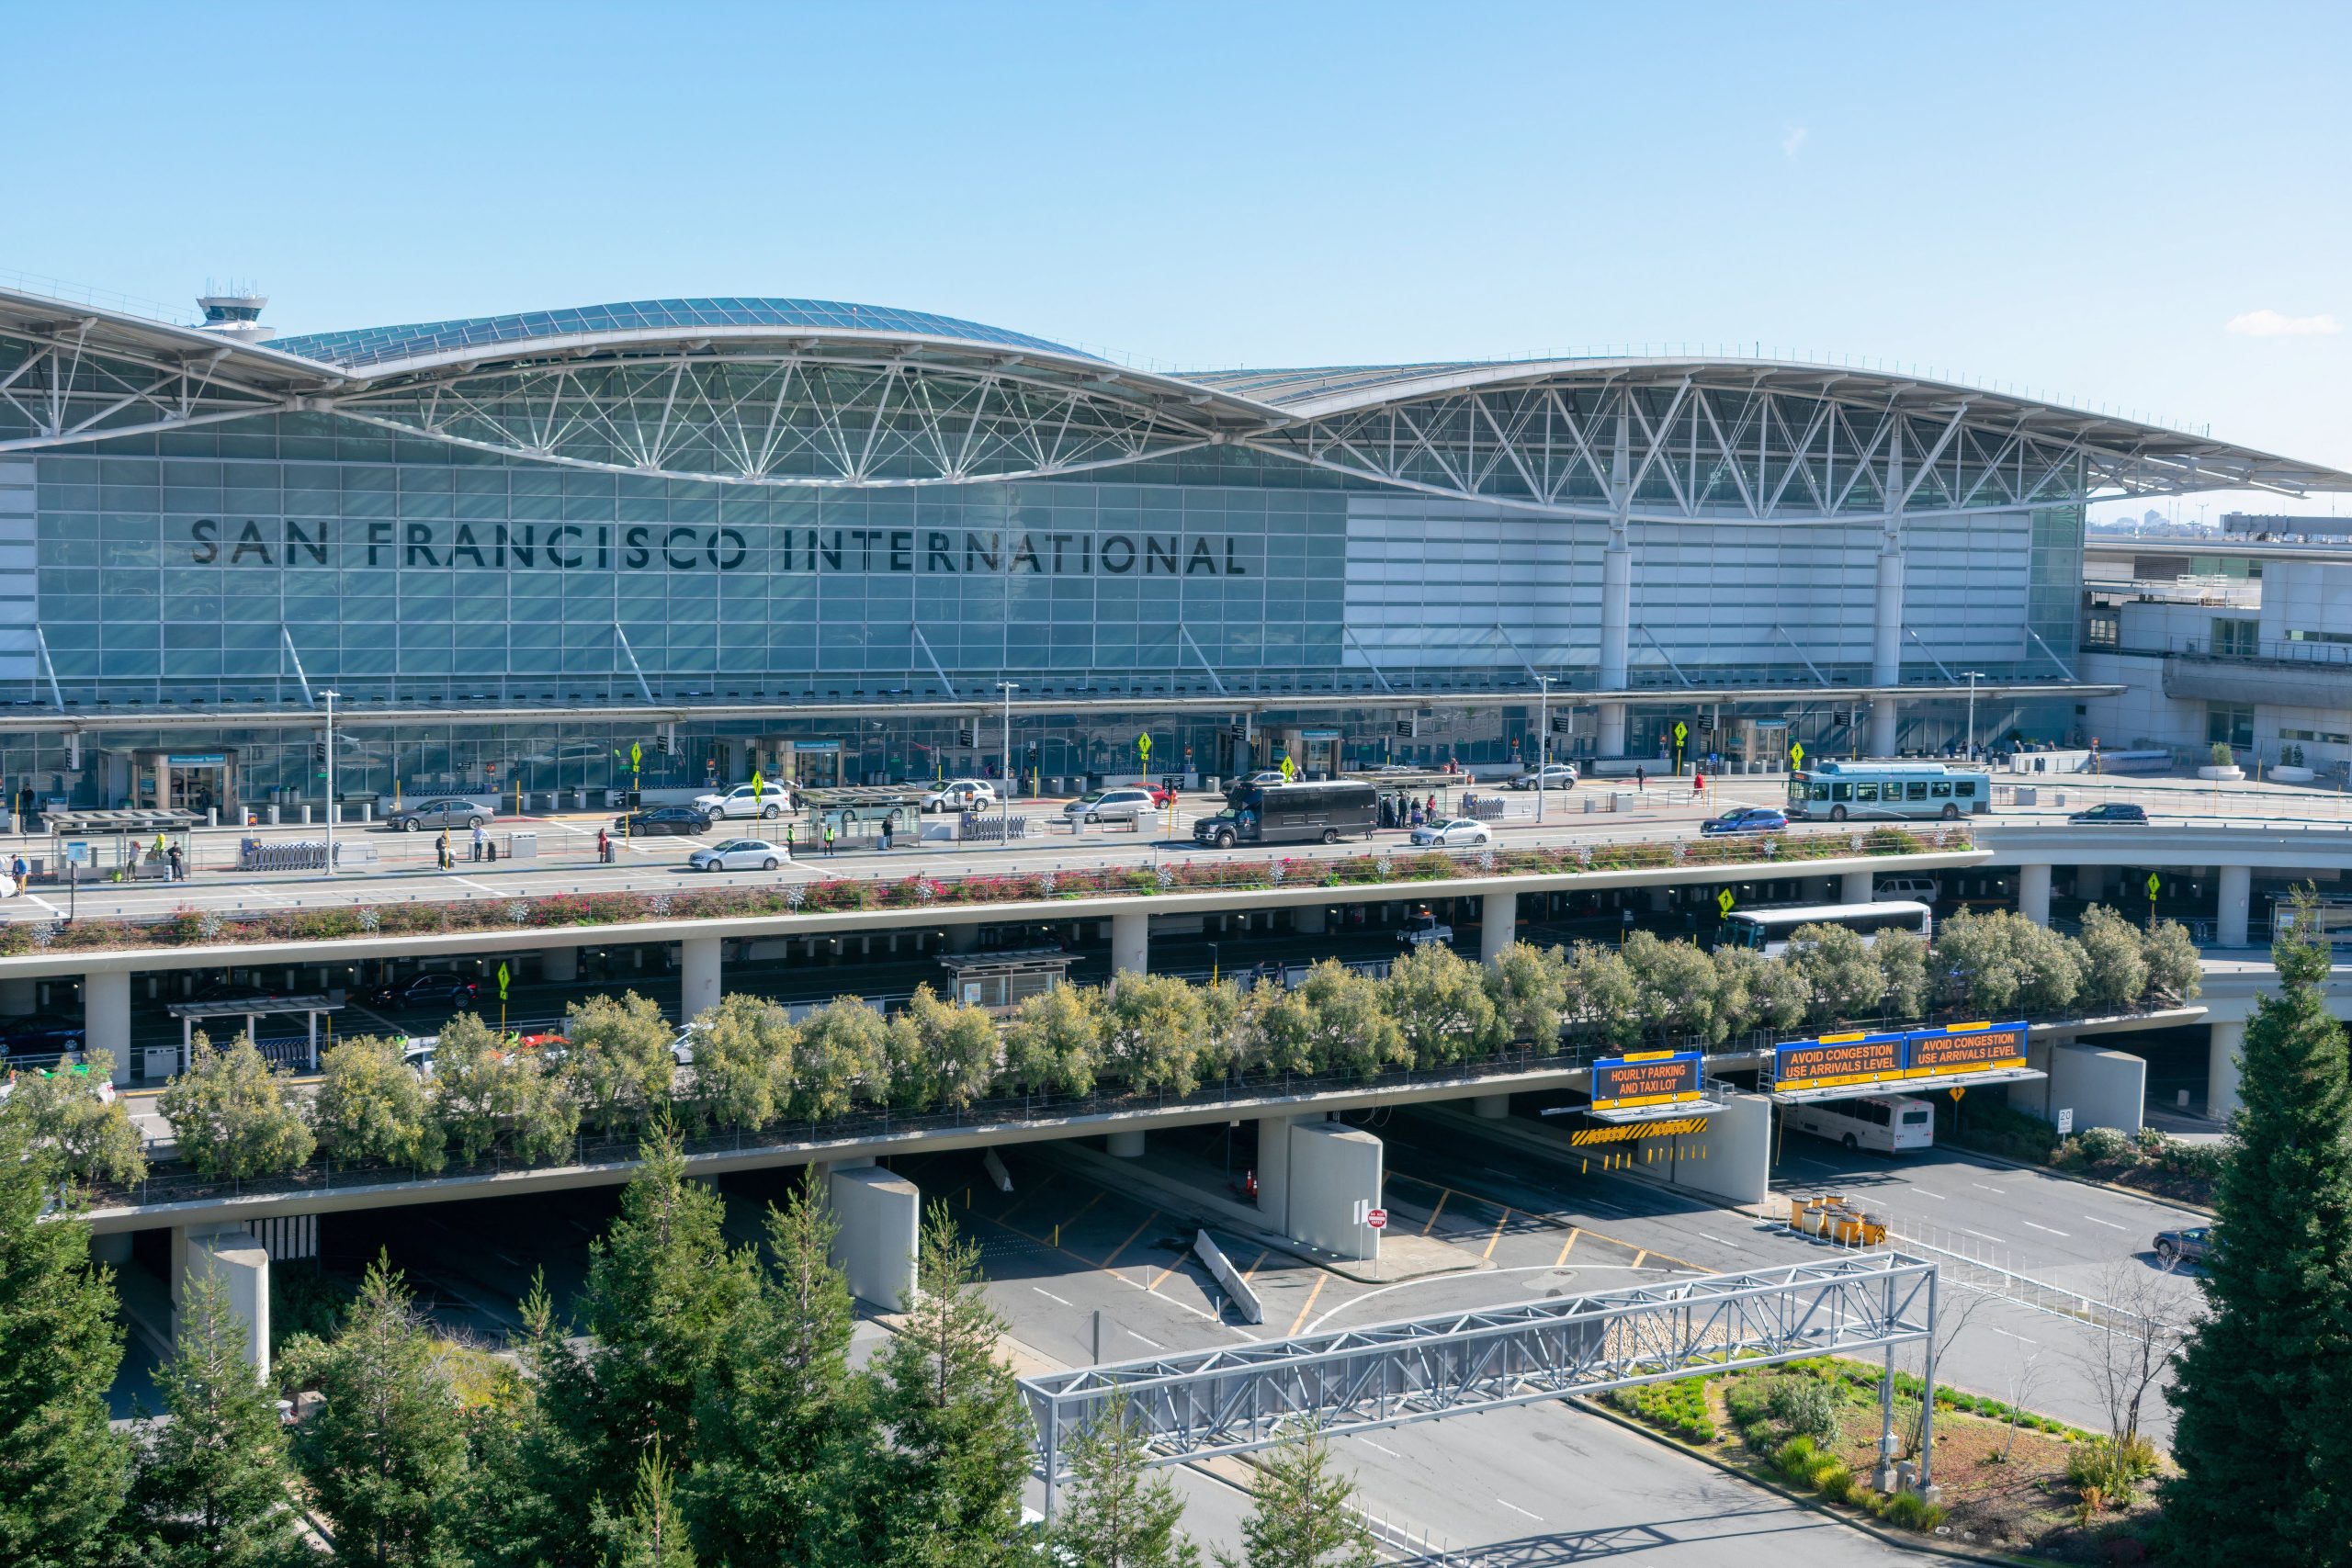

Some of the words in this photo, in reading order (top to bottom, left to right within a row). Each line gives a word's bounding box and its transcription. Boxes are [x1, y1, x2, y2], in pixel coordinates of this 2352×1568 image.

[191, 519, 328, 566] SAN
[368, 522, 748, 570] FRANCISCO
[784, 528, 1246, 575] INTERNATIONAL
[1922, 1038, 1951, 1052] AVOID
[1953, 1032, 2015, 1049] CONGESTION
[1637, 1053, 1660, 1061] Domestic
[1791, 1051, 1824, 1065] AVOID
[1826, 1044, 1894, 1061] CONGESTION
[1917, 1052, 1938, 1065] USE
[1939, 1047, 1986, 1063] ARRIVALS
[1988, 1045, 2017, 1058] LEVEL
[1611, 1068, 1647, 1081] HOURLY
[1648, 1065, 1685, 1078] PARKING
[1785, 1066, 1807, 1078] USE
[1809, 1060, 1861, 1076] ARRIVALS
[1863, 1057, 1895, 1070] LEVEL
[1619, 1082, 1638, 1094] AND
[1640, 1080, 1659, 1093] TAXI
[1659, 1078, 1677, 1091] LOT
[2060, 1111, 2070, 1120] 20
